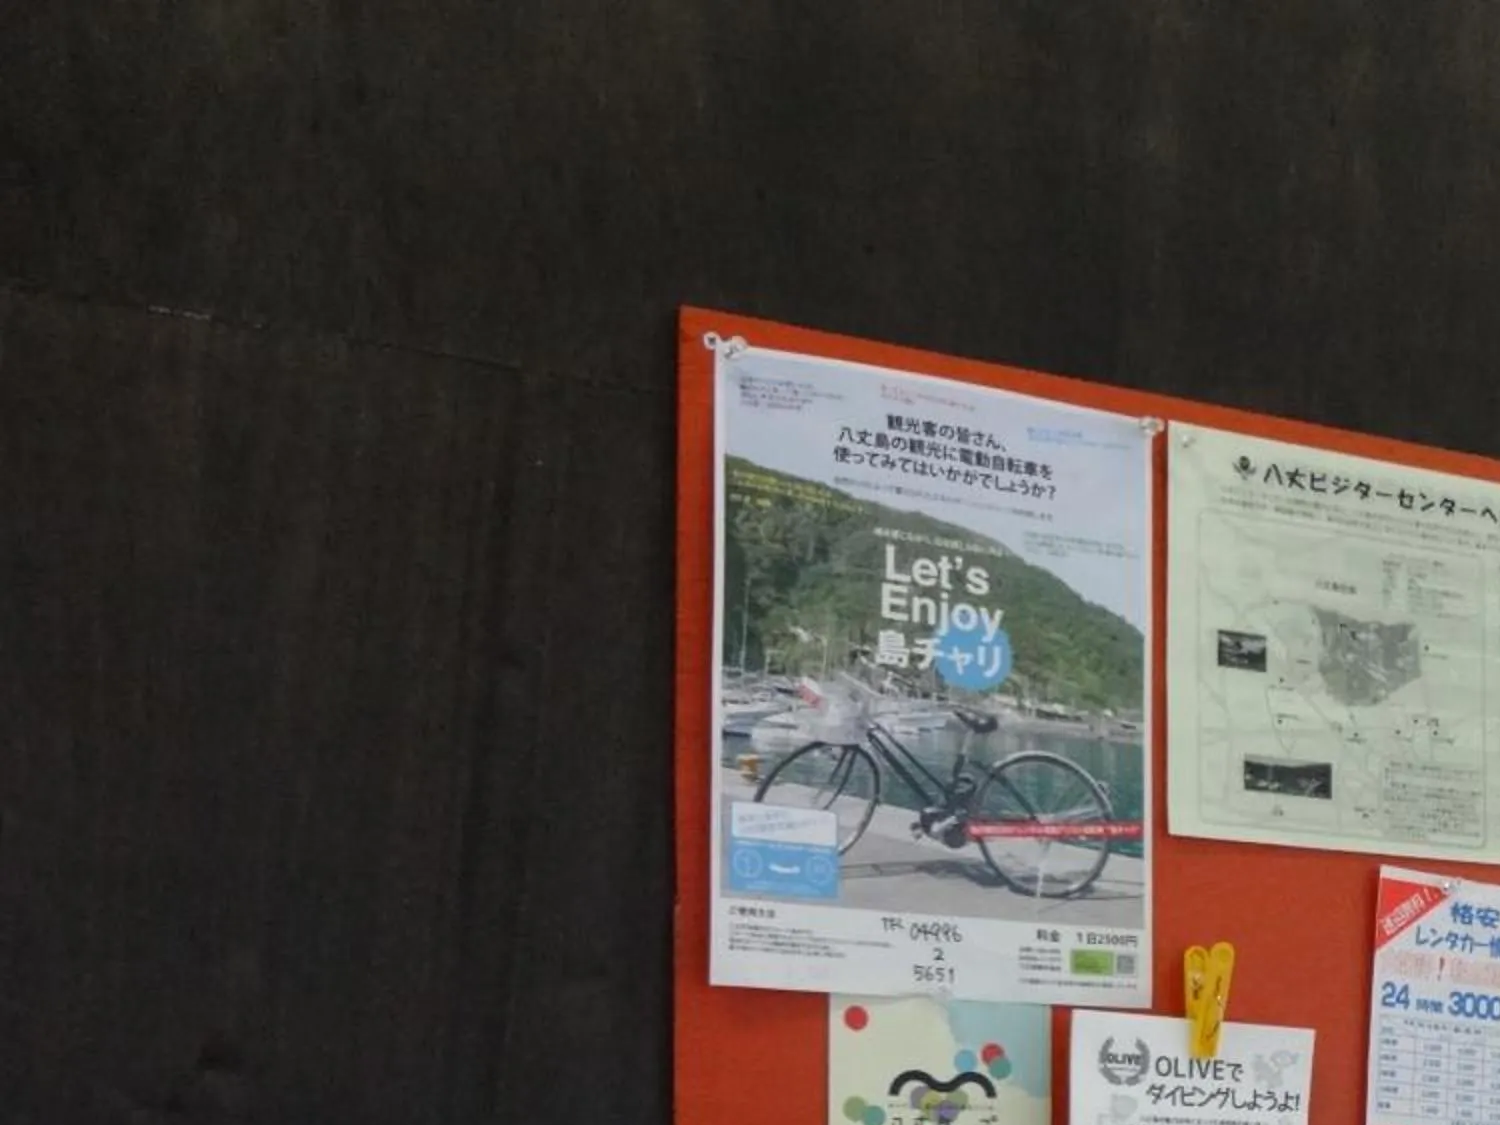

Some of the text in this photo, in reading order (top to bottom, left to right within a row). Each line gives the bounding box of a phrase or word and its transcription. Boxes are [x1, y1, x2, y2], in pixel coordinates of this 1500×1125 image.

[885, 544, 990, 596] Let's
[881, 582, 1003, 644] Enjoy
[875, 629, 1002, 677] 島チャリ
[932, 947, 946, 962] 2
[1155, 1055, 1244, 1082] OLIVEで
